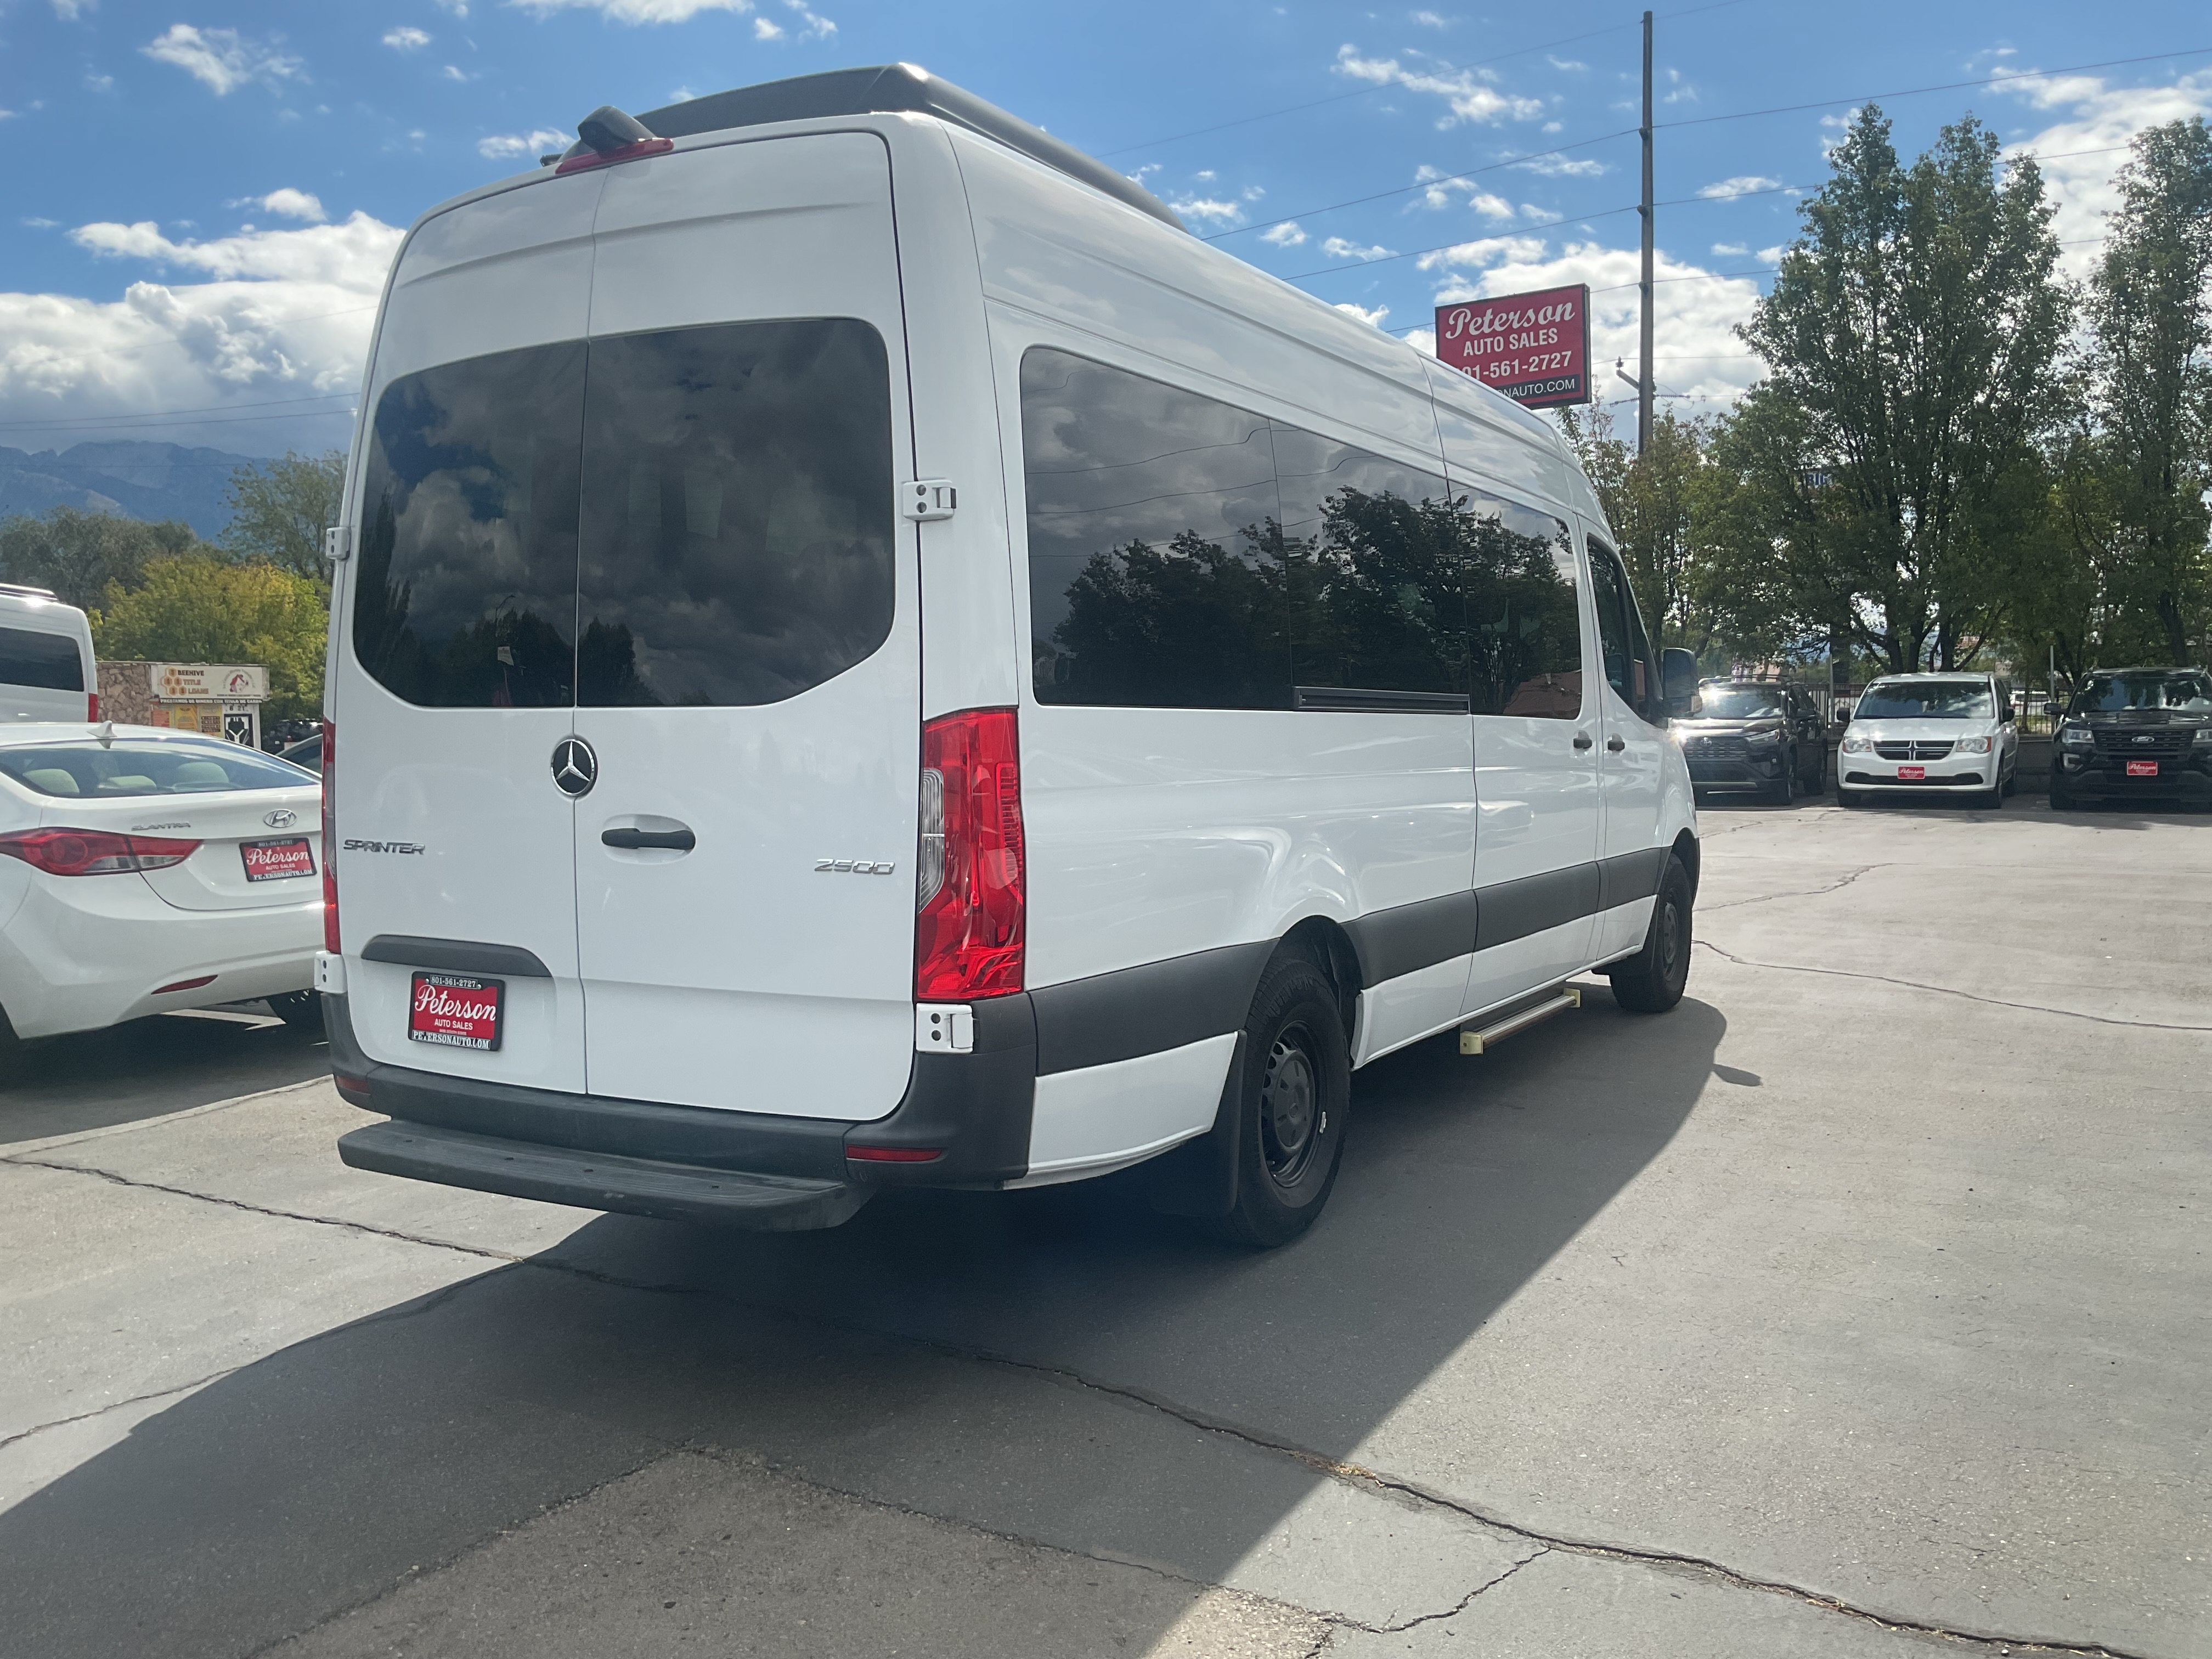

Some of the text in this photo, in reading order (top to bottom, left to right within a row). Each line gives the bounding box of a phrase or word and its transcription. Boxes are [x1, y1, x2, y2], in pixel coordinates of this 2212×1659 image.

[1445, 302, 1575, 339] Peterson
[1463, 328, 1558, 357] AUTO SALES
[1455, 351, 1572, 380] 01-561-2727
[343, 839, 426, 855] SPRINTER
[246, 848, 309, 865] Peterson
[814, 858, 895, 875] 2500
[431, 976, 476, 988] 801-561-2727
[415, 984, 496, 1021] Peterson
[434, 1018, 473, 1030] AUTO SALES
